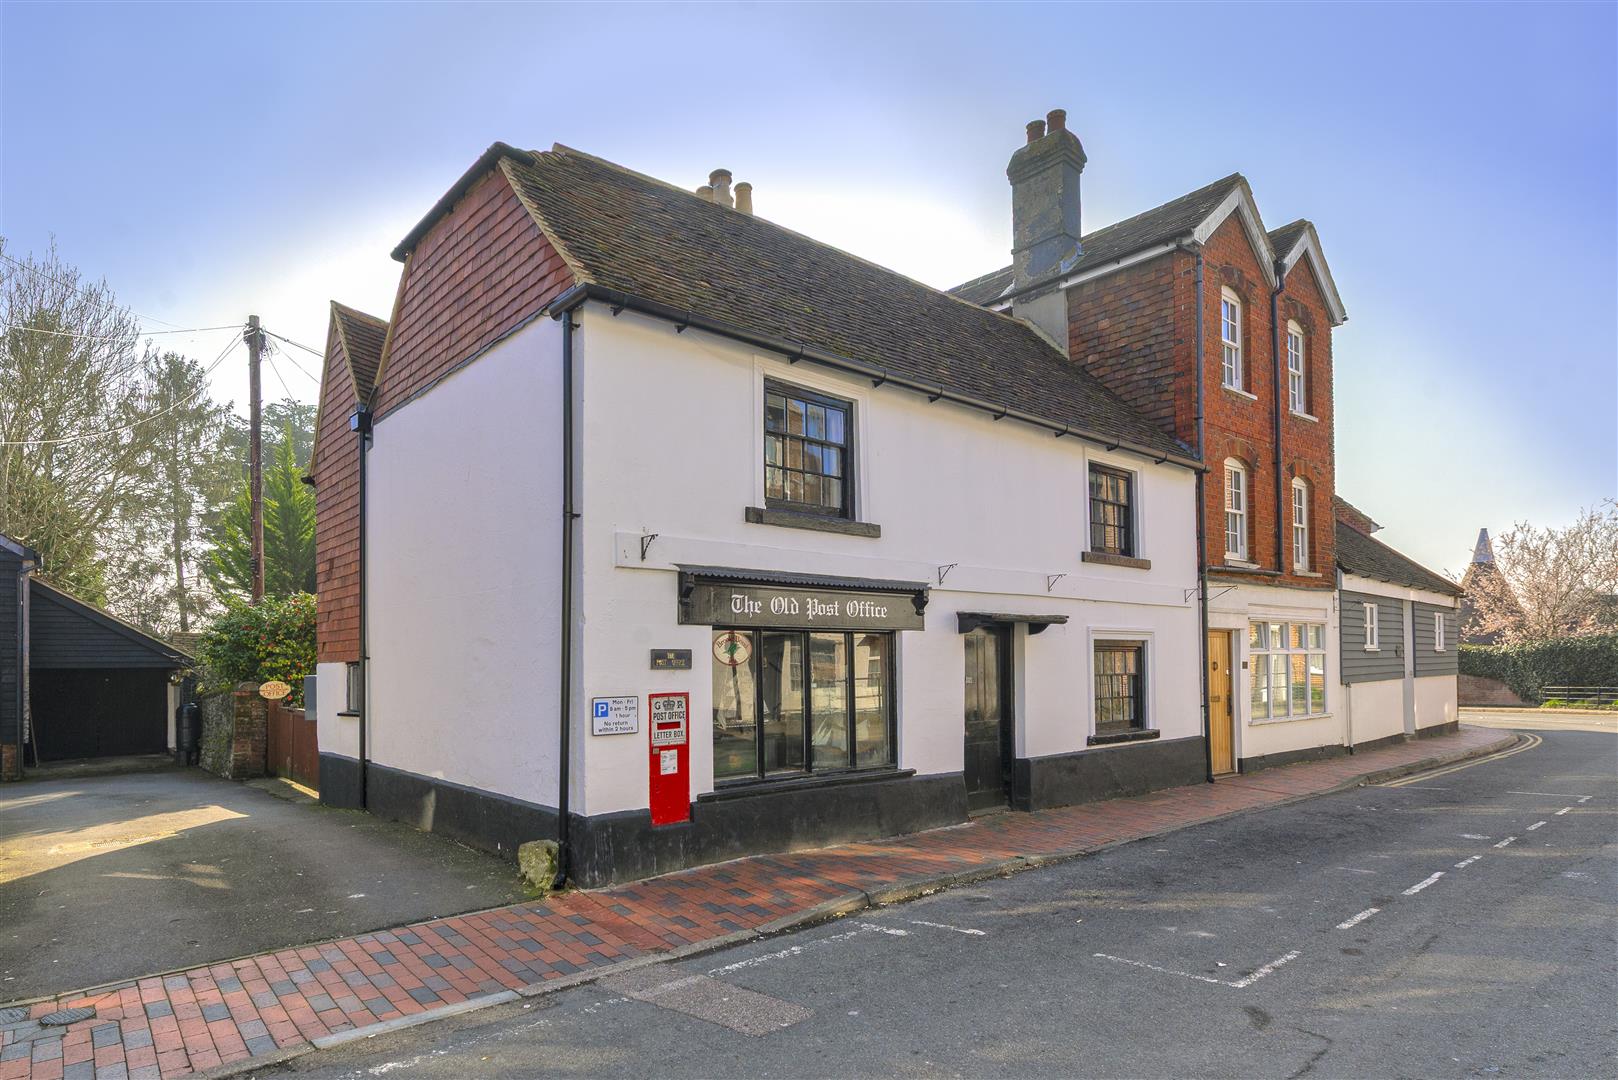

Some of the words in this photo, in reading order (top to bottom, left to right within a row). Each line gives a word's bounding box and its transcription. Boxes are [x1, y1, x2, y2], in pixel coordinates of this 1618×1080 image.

[731, 594, 762, 618] The
[770, 596, 799, 615] Old
[806, 597, 840, 620] Post
[846, 600, 888, 618] Office
[598, 704, 607, 716] P
[654, 702, 661, 710] G
[677, 700, 684, 709] R
[653, 712, 667, 721] POST
[668, 710, 686, 720] OFFICE
[654, 732, 672, 740] LETTER
[673, 730, 684, 738] BOX
